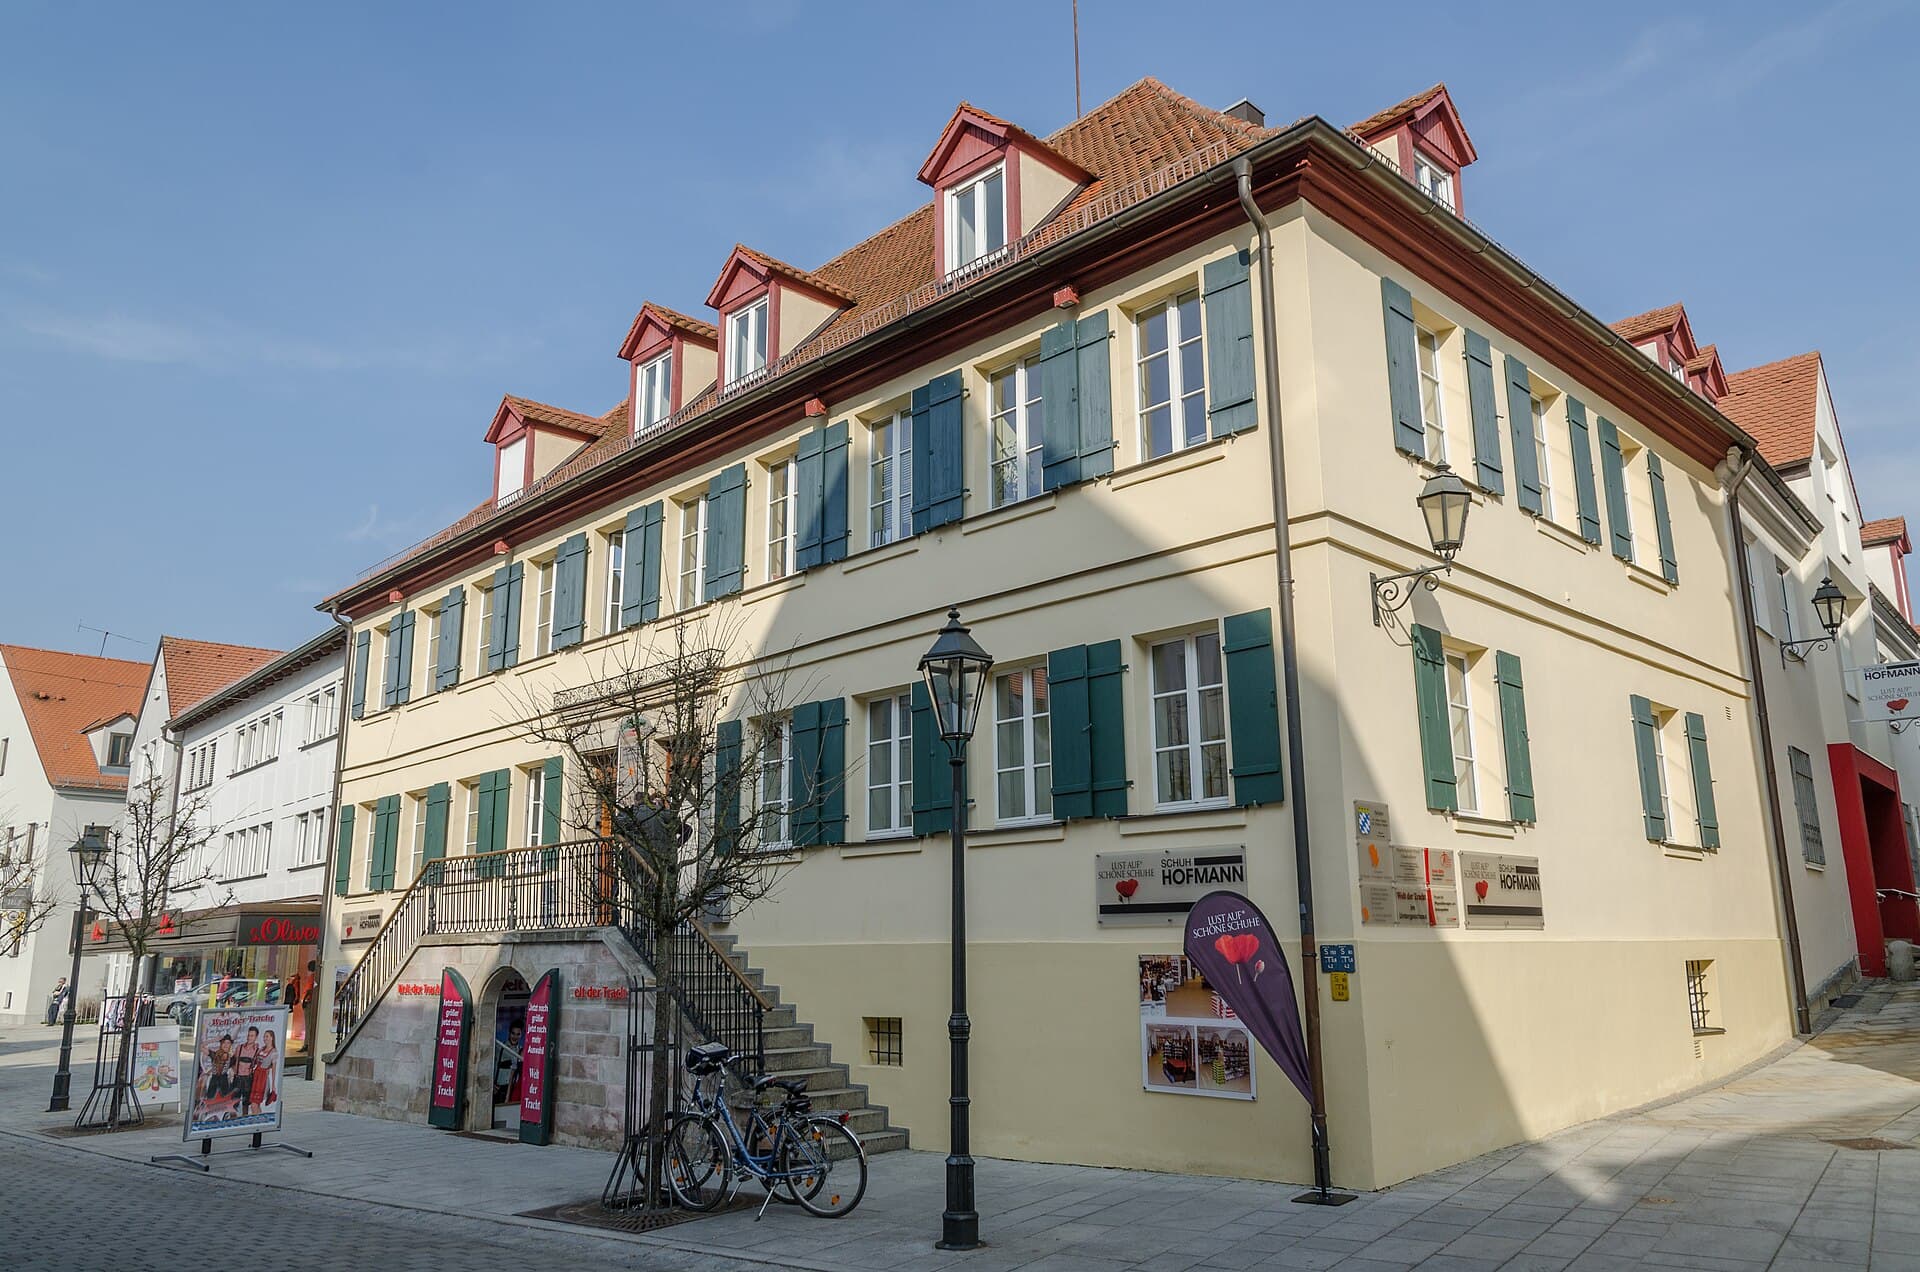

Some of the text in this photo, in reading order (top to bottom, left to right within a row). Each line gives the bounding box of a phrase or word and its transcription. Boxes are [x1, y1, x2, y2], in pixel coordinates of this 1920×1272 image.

[1864, 667, 1920, 680] HOFMANN
[1111, 861, 1127, 870] LUST
[1161, 858, 1192, 868] SCHUH
[1126, 868, 1154, 878] SCHUHE
[1162, 866, 1244, 885] HOFMANN
[1500, 874, 1541, 891] HOFMANN
[1207, 913, 1225, 926] LUST
[1227, 917, 1260, 932] SCHUHE
[423, 984, 440, 995] Trach
[587, 986, 601, 998] der
[602, 986, 628, 999] Trach
[211, 1014, 274, 1026] Welt der Tracht
[442, 1057, 454, 1068] Welt
[442, 1071, 452, 1082] der
[529, 1067, 540, 1080] Welt
[438, 1085, 454, 1097] Tracht
[529, 1083, 538, 1095] der
[525, 1097, 541, 1111] Tracht
